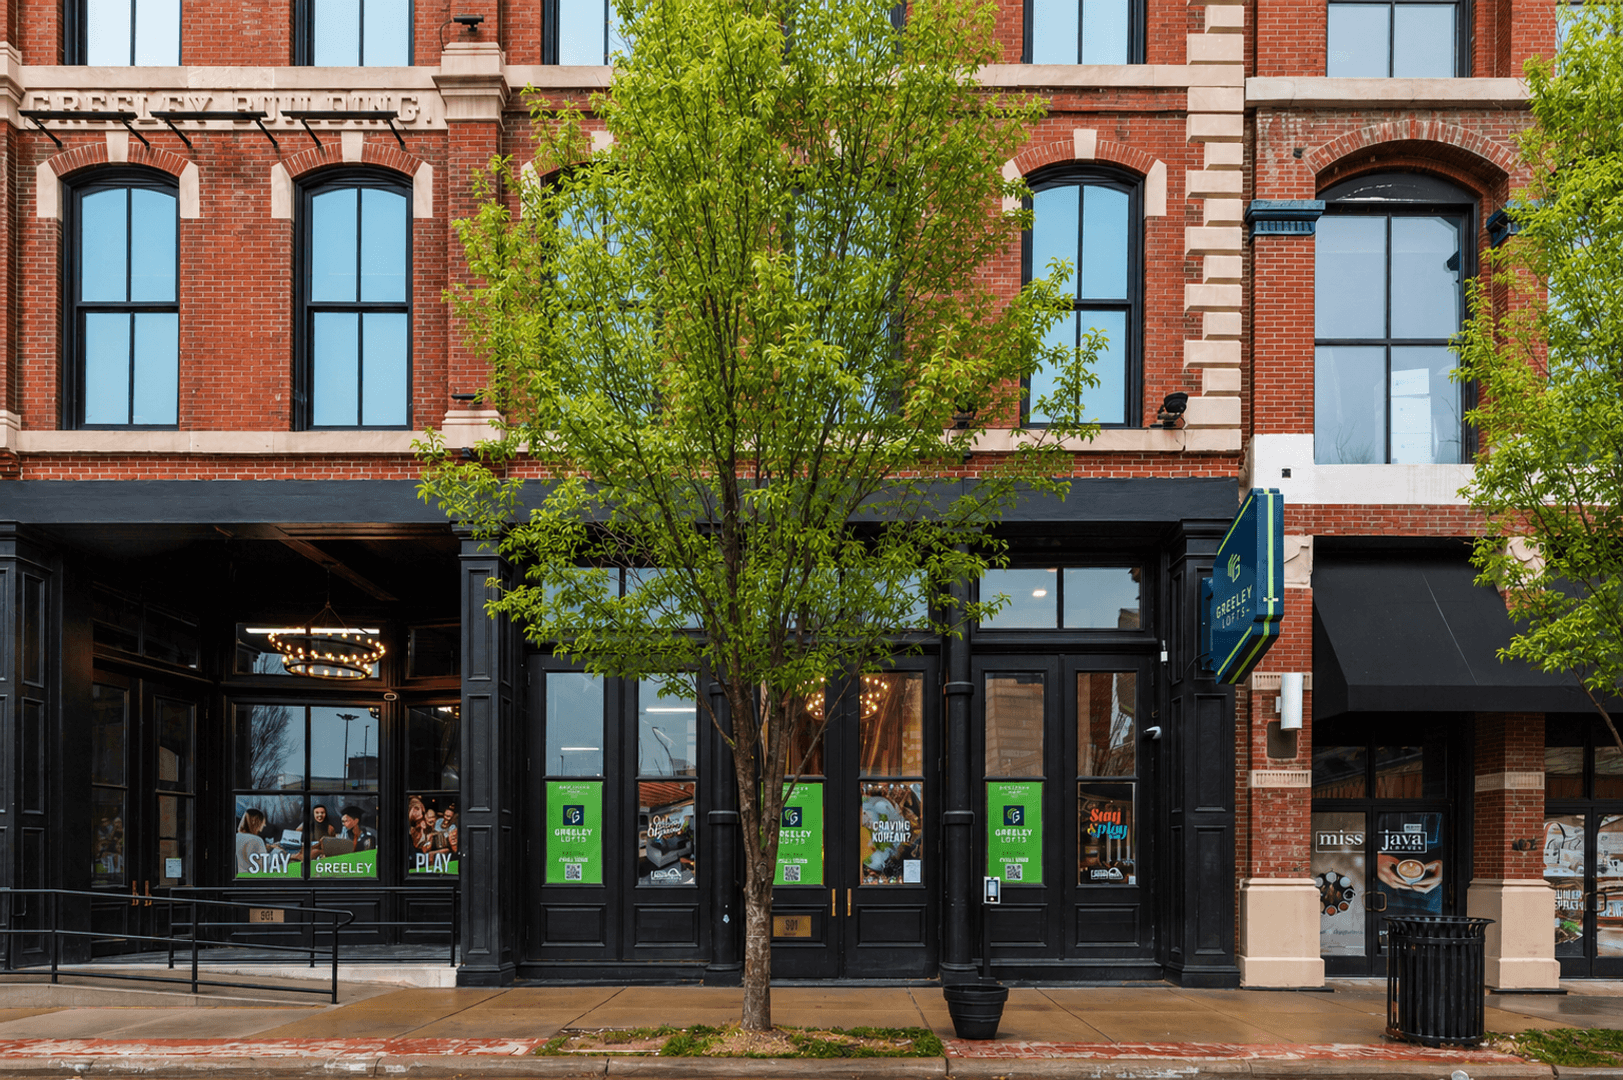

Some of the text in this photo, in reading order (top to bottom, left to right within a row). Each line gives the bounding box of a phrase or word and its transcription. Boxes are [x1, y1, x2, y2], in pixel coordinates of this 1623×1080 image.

[1216, 584, 1252, 618] GREELEY
[873, 820, 911, 831] CRAVING
[1089, 808, 1121, 825] Stay
[872, 832, 912, 843] KOREAN?
[1319, 829, 1423, 851] miss java
[248, 853, 291, 874] STAY
[315, 862, 373, 874] GREELEY
[415, 852, 452, 874] PLAY
